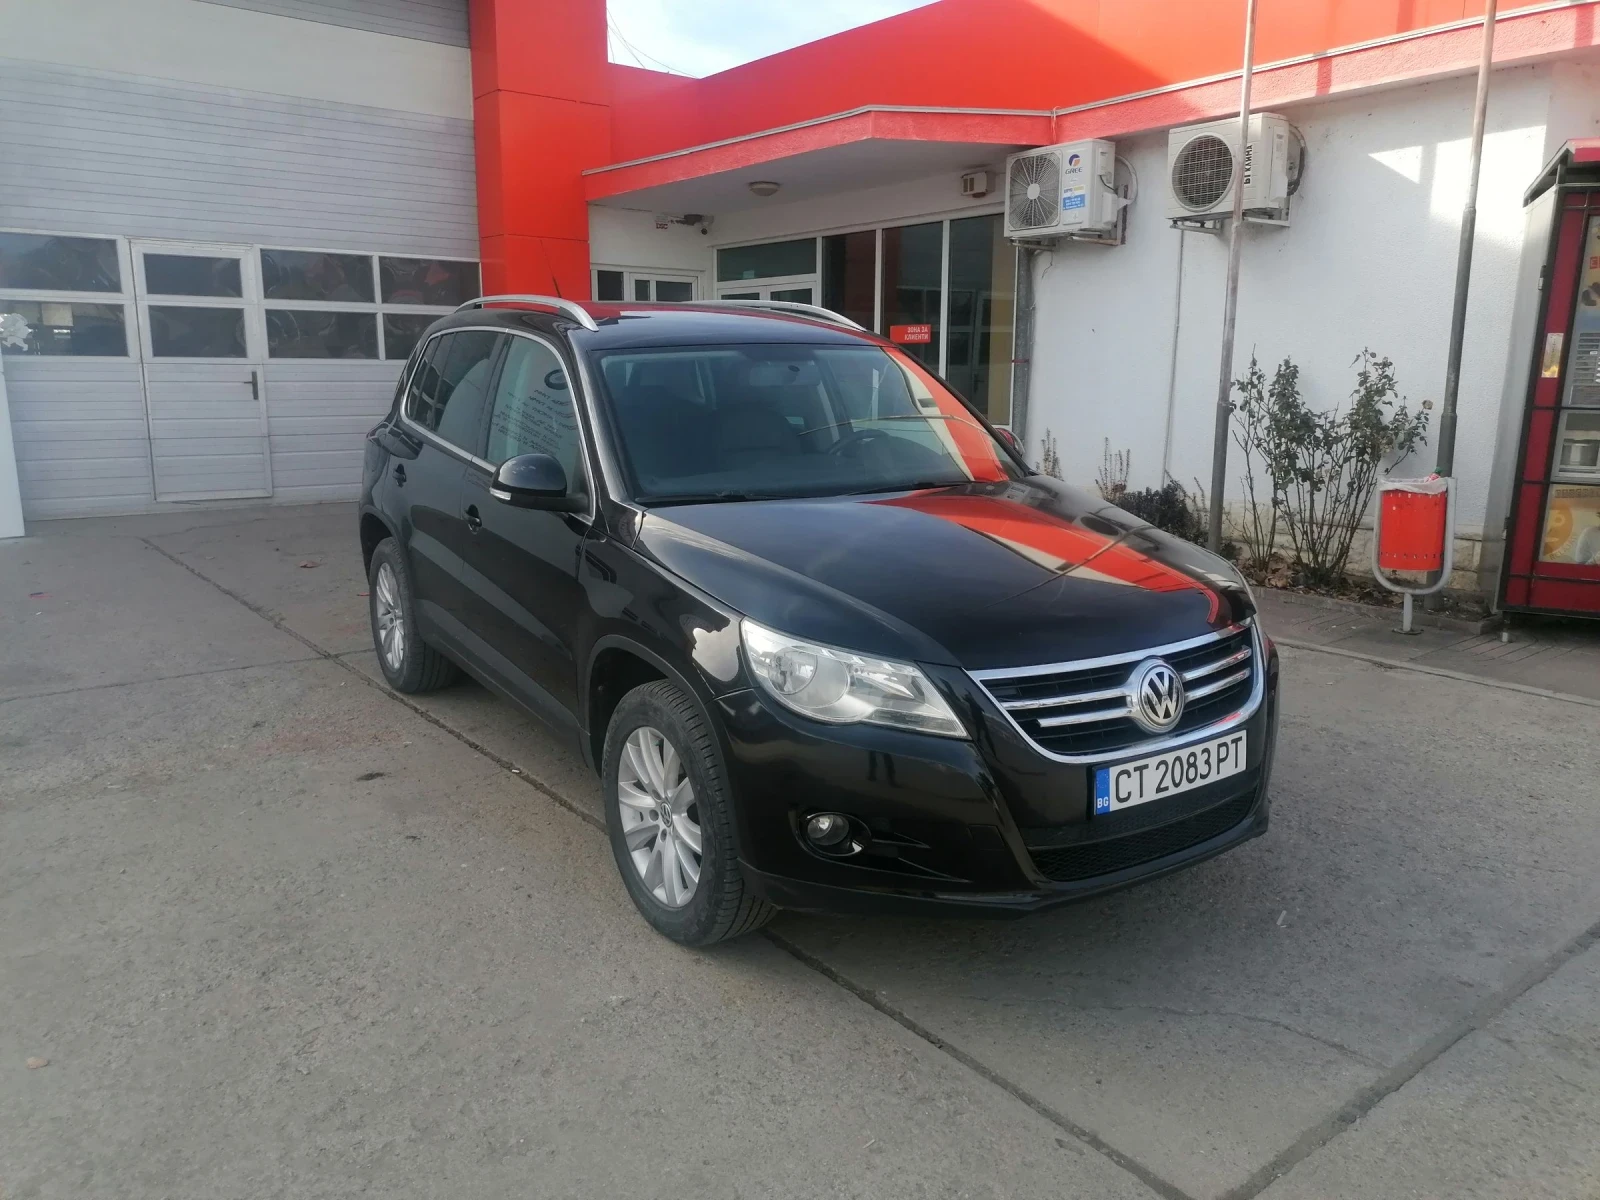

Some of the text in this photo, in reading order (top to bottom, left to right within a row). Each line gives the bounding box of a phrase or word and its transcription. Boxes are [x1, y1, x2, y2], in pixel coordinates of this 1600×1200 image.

[1065, 166, 1083, 175] GREE
[1114, 736, 1243, 804] CT 2083 PT
[1096, 796, 1109, 809] BG
